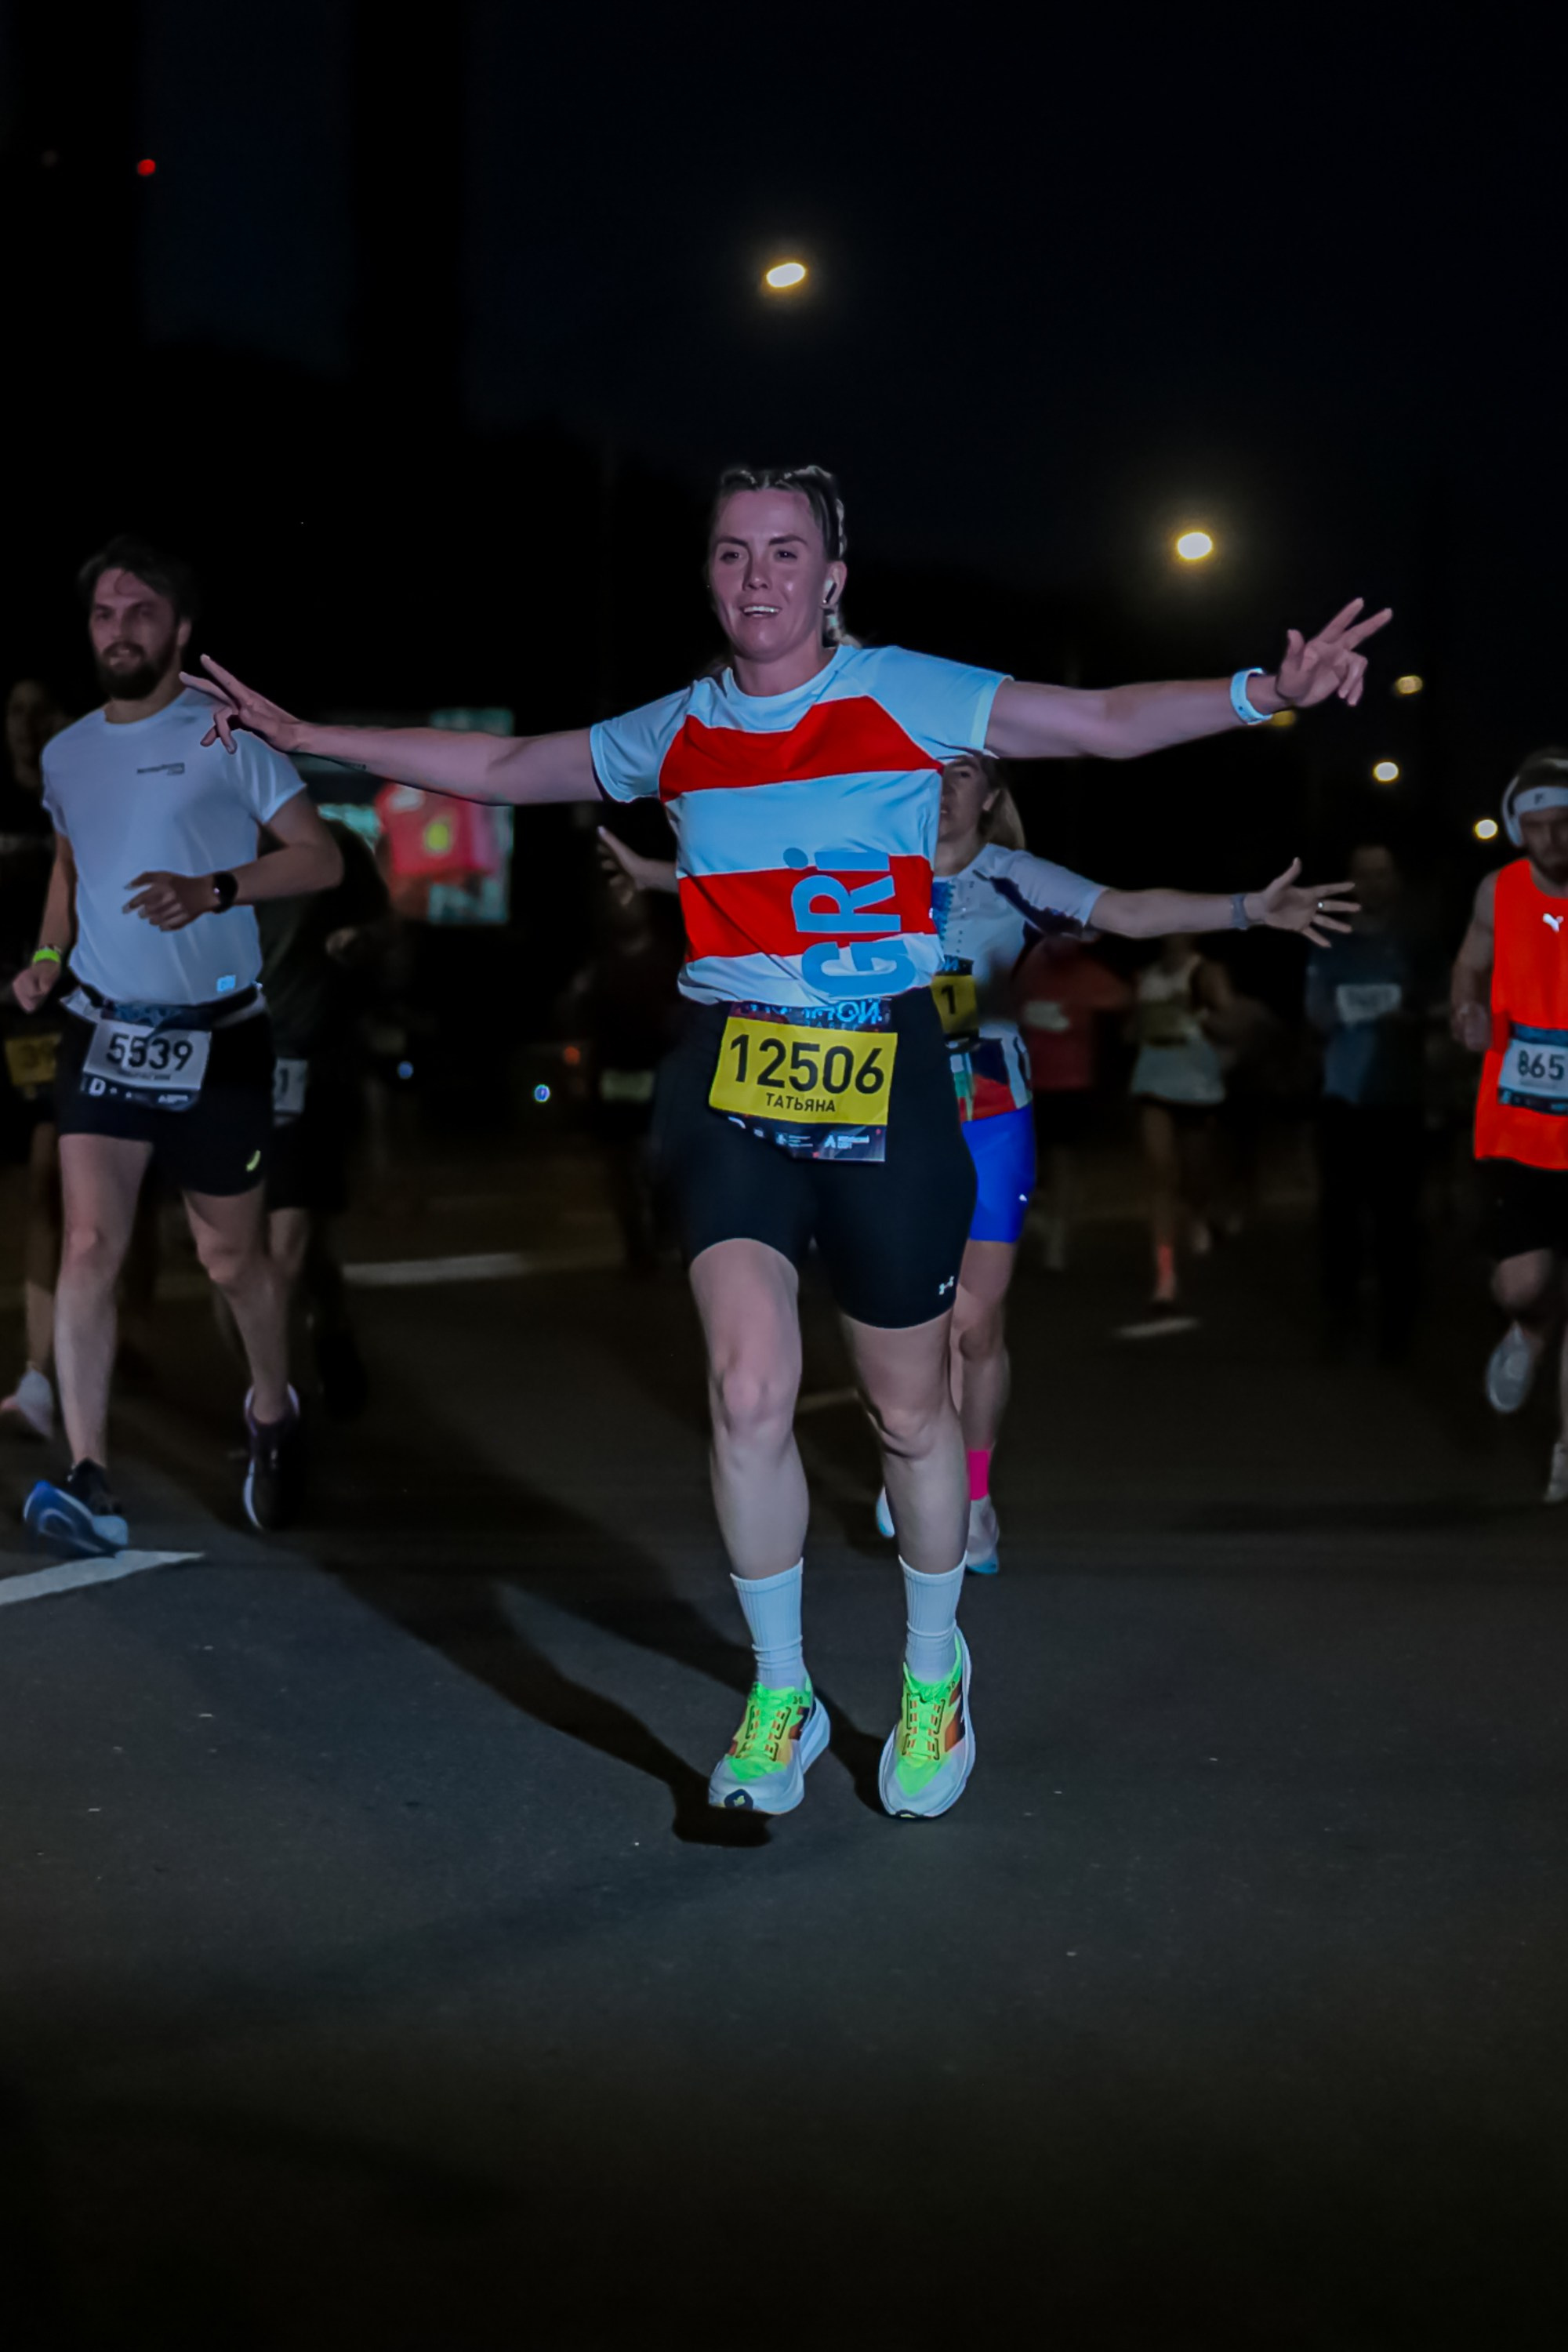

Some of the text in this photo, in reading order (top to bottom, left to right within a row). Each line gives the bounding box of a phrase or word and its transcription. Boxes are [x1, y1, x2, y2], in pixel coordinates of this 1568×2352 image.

[784, 848, 916, 997] GRi
[107, 1033, 193, 1071] 5539
[730, 1033, 885, 1094] 12506
[1518, 1049, 1565, 1080] 865
[765, 1092, 837, 1112] ТАТЬЯНА
